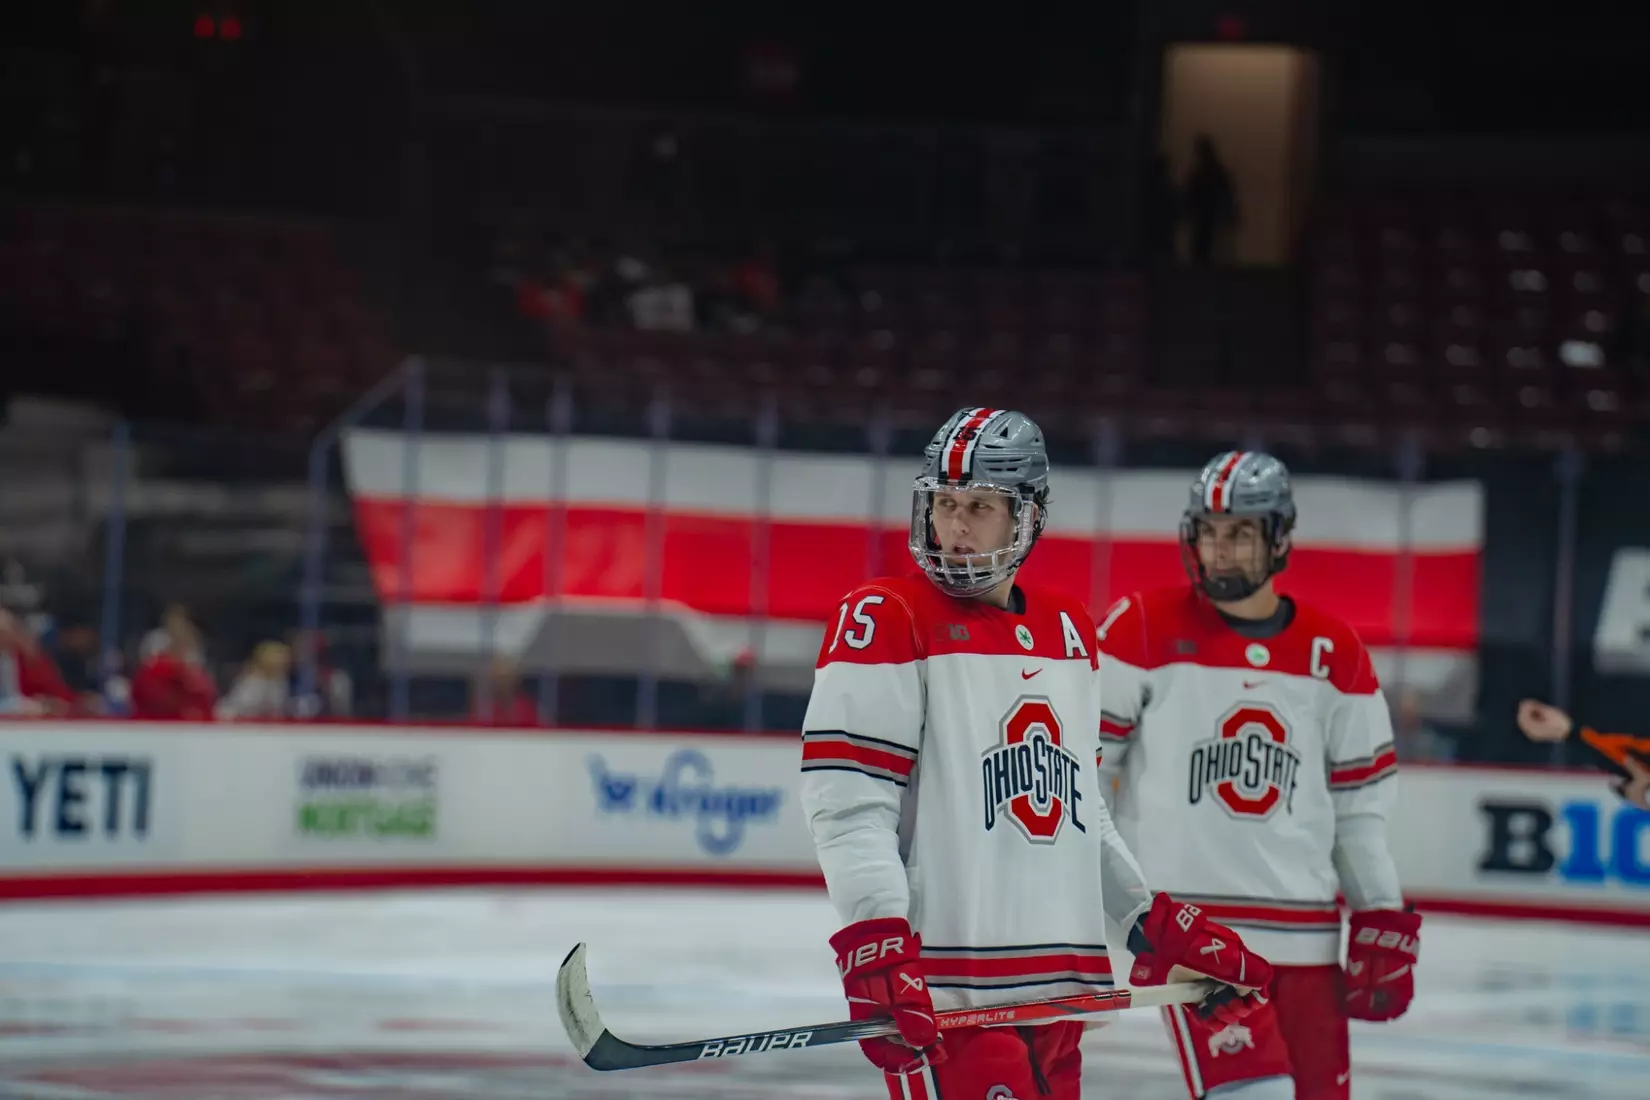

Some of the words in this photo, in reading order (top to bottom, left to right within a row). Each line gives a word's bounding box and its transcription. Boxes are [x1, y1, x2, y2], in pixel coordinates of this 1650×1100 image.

[829, 595, 885, 653] 15
[1059, 611, 1089, 658] A
[1311, 636, 1334, 679] C
[12, 757, 153, 838] YETI
[940, 1010, 1015, 1027] HYPERLITE
[699, 1031, 813, 1060] BAUER
